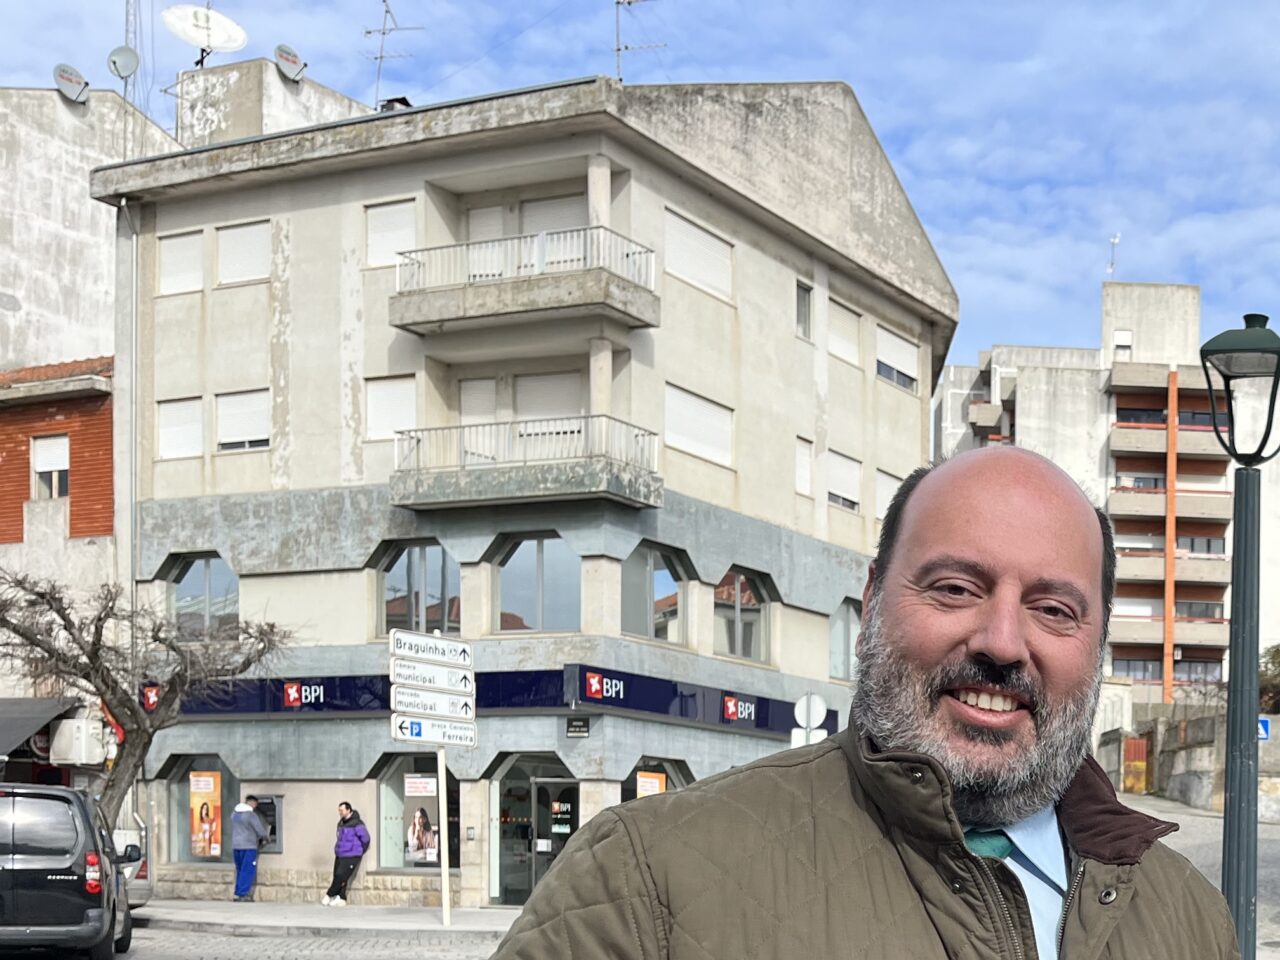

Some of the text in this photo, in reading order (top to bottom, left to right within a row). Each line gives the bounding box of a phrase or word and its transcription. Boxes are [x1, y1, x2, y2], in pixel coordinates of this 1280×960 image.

[395, 638, 446, 657] Braguinha
[396, 671, 435, 684] municipal
[301, 684, 324, 703] BPI
[603, 677, 624, 699] BPI
[397, 699, 436, 712] municipal
[737, 700, 755, 720] BPI
[442, 730, 474, 743] Ferreira
